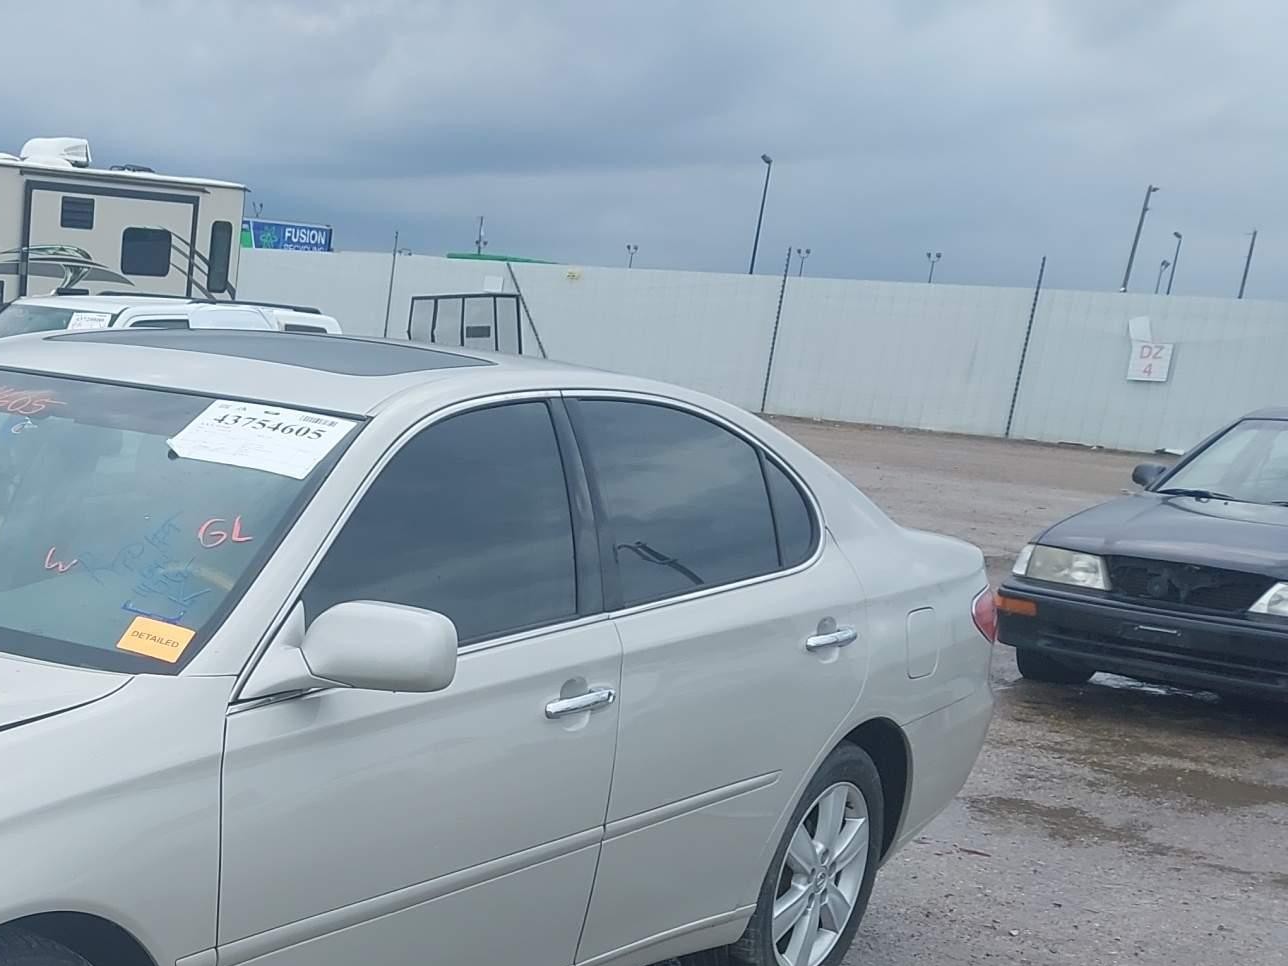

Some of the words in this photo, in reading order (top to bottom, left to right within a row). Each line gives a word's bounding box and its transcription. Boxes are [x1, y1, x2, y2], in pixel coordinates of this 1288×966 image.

[284, 227, 326, 245] FUSION
[1140, 345, 1165, 359] DZ
[1143, 363, 1152, 377] 4
[213, 413, 328, 440] 43754605
[198, 515, 254, 548] GL
[130, 629, 180, 649] DETAILED
